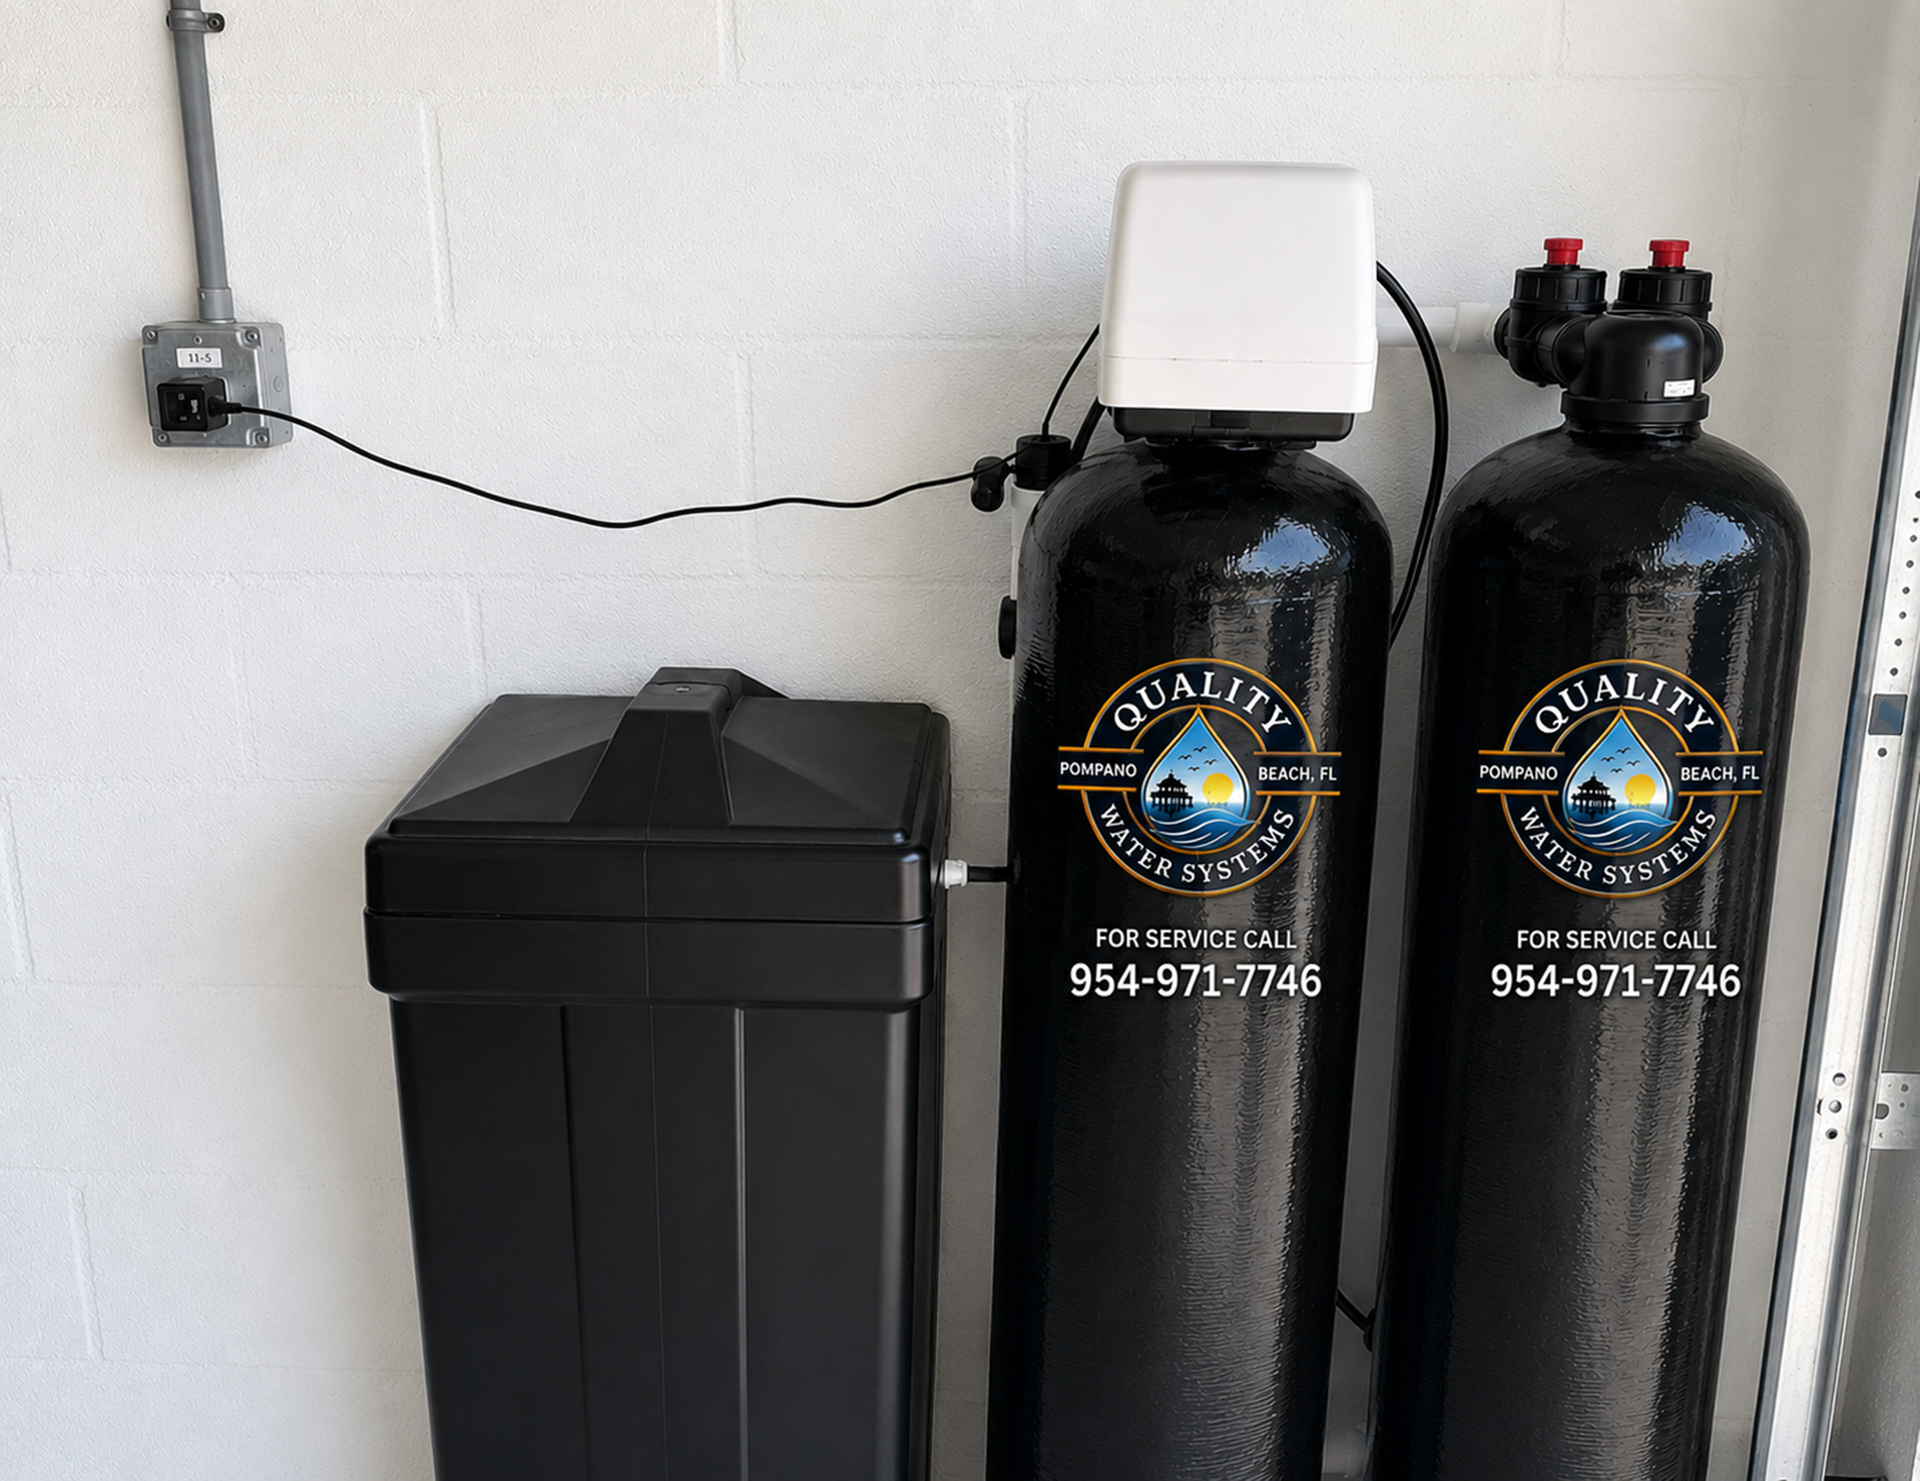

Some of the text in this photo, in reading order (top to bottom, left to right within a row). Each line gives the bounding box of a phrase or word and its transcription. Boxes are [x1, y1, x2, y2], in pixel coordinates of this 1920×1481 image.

[1113, 670, 1291, 733] QUALITY
[1535, 672, 1715, 734] QUALITY
[1060, 761, 1337, 782] POMPANO BEACH, FL
[1479, 764, 1760, 783] POMPANO BEACH, FL
[1100, 803, 1295, 883] WATER SYSTEMS
[1520, 806, 1717, 884] WATER SYSTEMS
[1096, 928, 1297, 949] FOR SERVICE CALL
[1517, 930, 1717, 949] FOR SERVICE CALL
[1069, 962, 1322, 997] 954-971-7746
[1491, 963, 1741, 997] 954-971-7746
